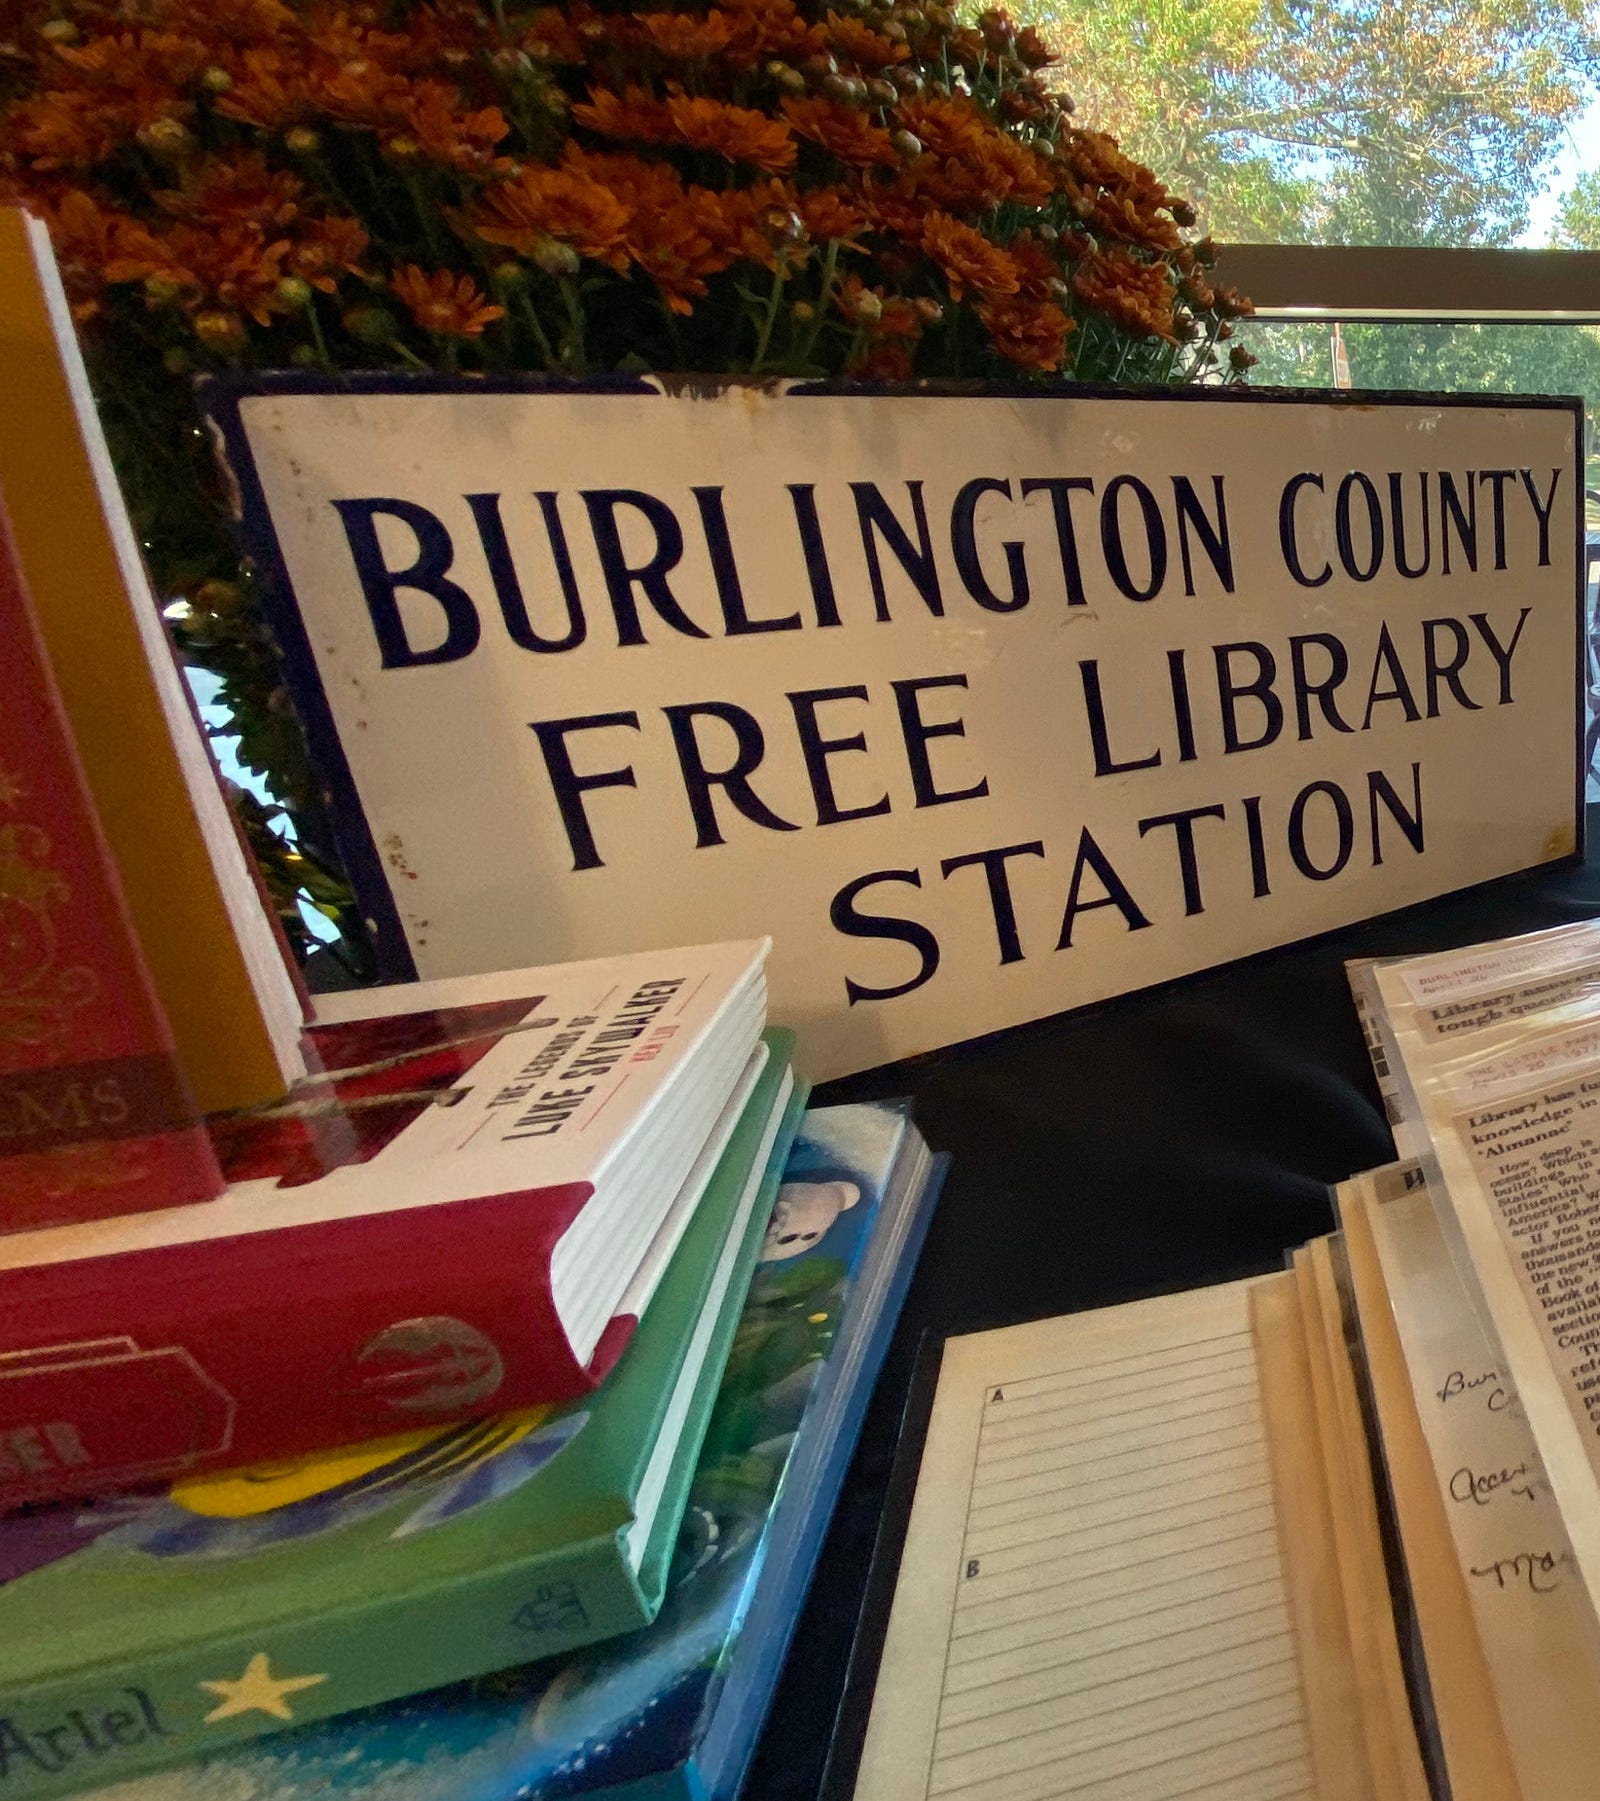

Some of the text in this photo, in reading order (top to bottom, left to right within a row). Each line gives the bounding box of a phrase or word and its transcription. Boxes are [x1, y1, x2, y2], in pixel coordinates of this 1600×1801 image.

[331, 468, 1562, 669] BURLINGTON COUNTY
[526, 607, 1532, 872] FREE LIBRARY
[829, 762, 1425, 1007] STATION
[1430, 989, 1515, 1020] Library
[1437, 1009, 1503, 1033] tough
[485, 1082, 536, 1109] THE
[513, 1030, 586, 1080] LEGENDS
[501, 977, 687, 1142] LUKE SKYWALKER
[628, 1042, 664, 1064] KEN
[1468, 1101, 1537, 1128] Library
[1542, 1090, 1576, 1105] has
[1471, 1098, 1598, 1144] knowledge in
[992, 1387, 1004, 1402] A
[966, 1560, 980, 1579] B
[0, 1687, 176, 1778] Ariel
